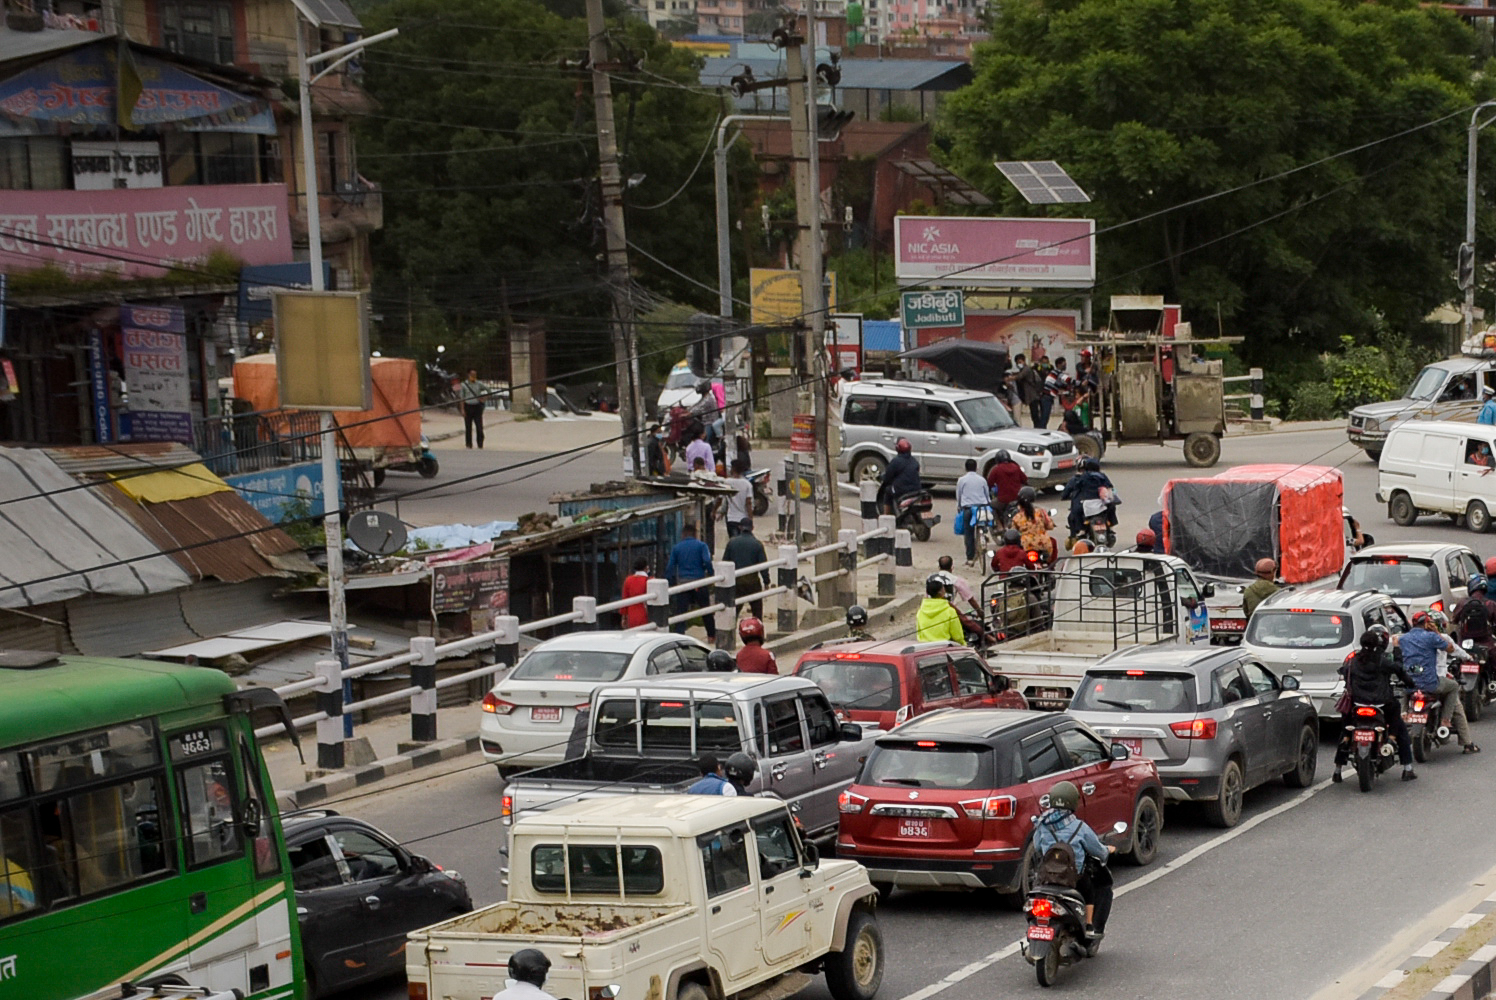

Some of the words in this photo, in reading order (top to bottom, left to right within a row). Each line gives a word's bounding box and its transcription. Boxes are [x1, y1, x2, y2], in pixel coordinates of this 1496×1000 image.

[46, 212, 128, 253] सम्बन्ध
[135, 210, 178, 245] एण्ड
[185, 197, 222, 242] गेष्ट
[229, 205, 277, 245] हाउस
[908, 243, 927, 254] NIC
[931, 243, 960, 254] ASIA
[908, 292, 959, 314] जडीबुटी
